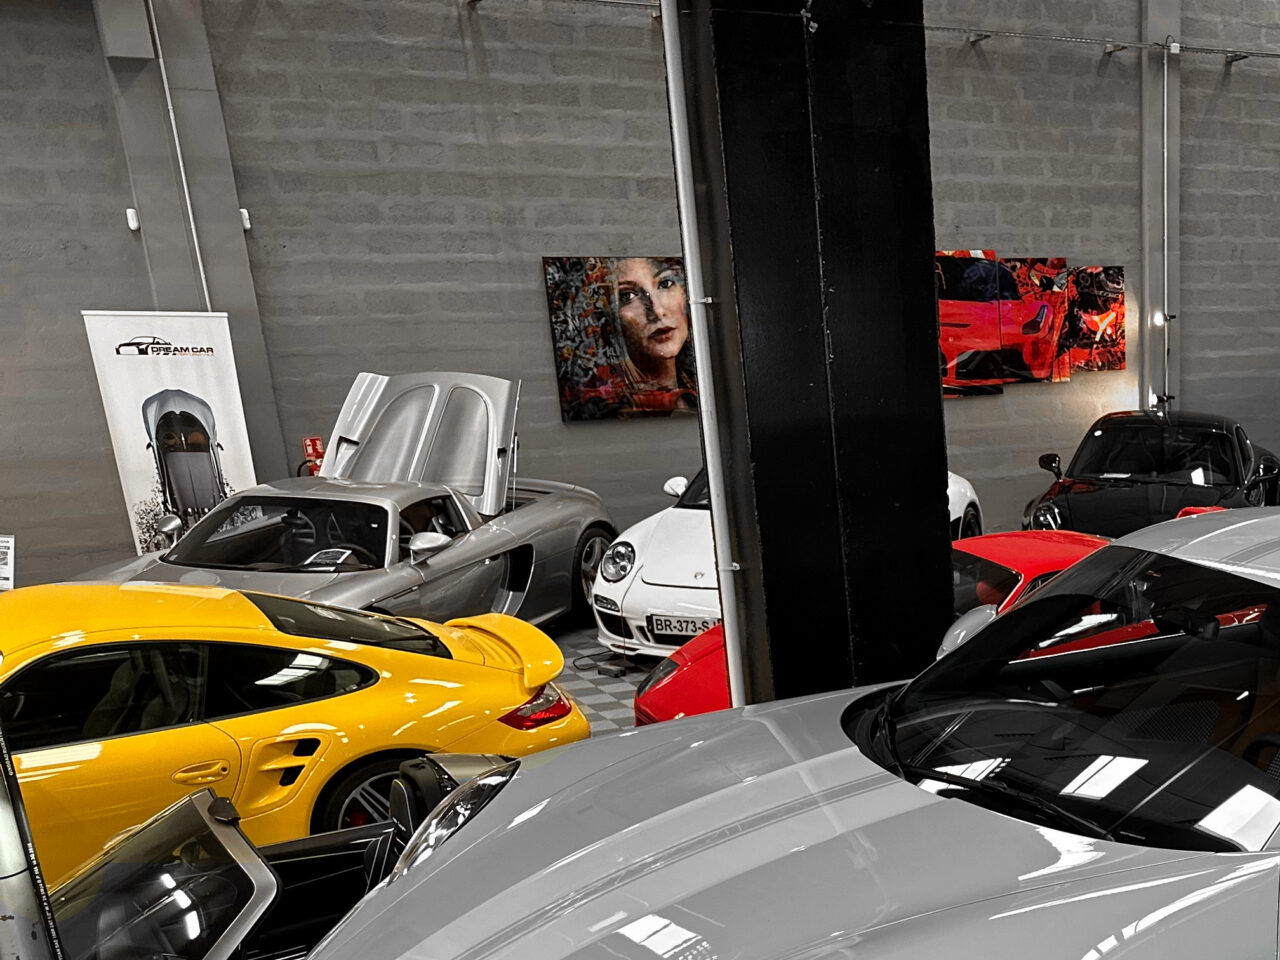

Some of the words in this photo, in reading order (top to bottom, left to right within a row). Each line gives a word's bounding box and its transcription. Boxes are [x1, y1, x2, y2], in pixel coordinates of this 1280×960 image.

[150, 346, 190, 354] DREAM
[191, 346, 214, 354] CAR
[655, 618, 722, 633] BR-373-S
